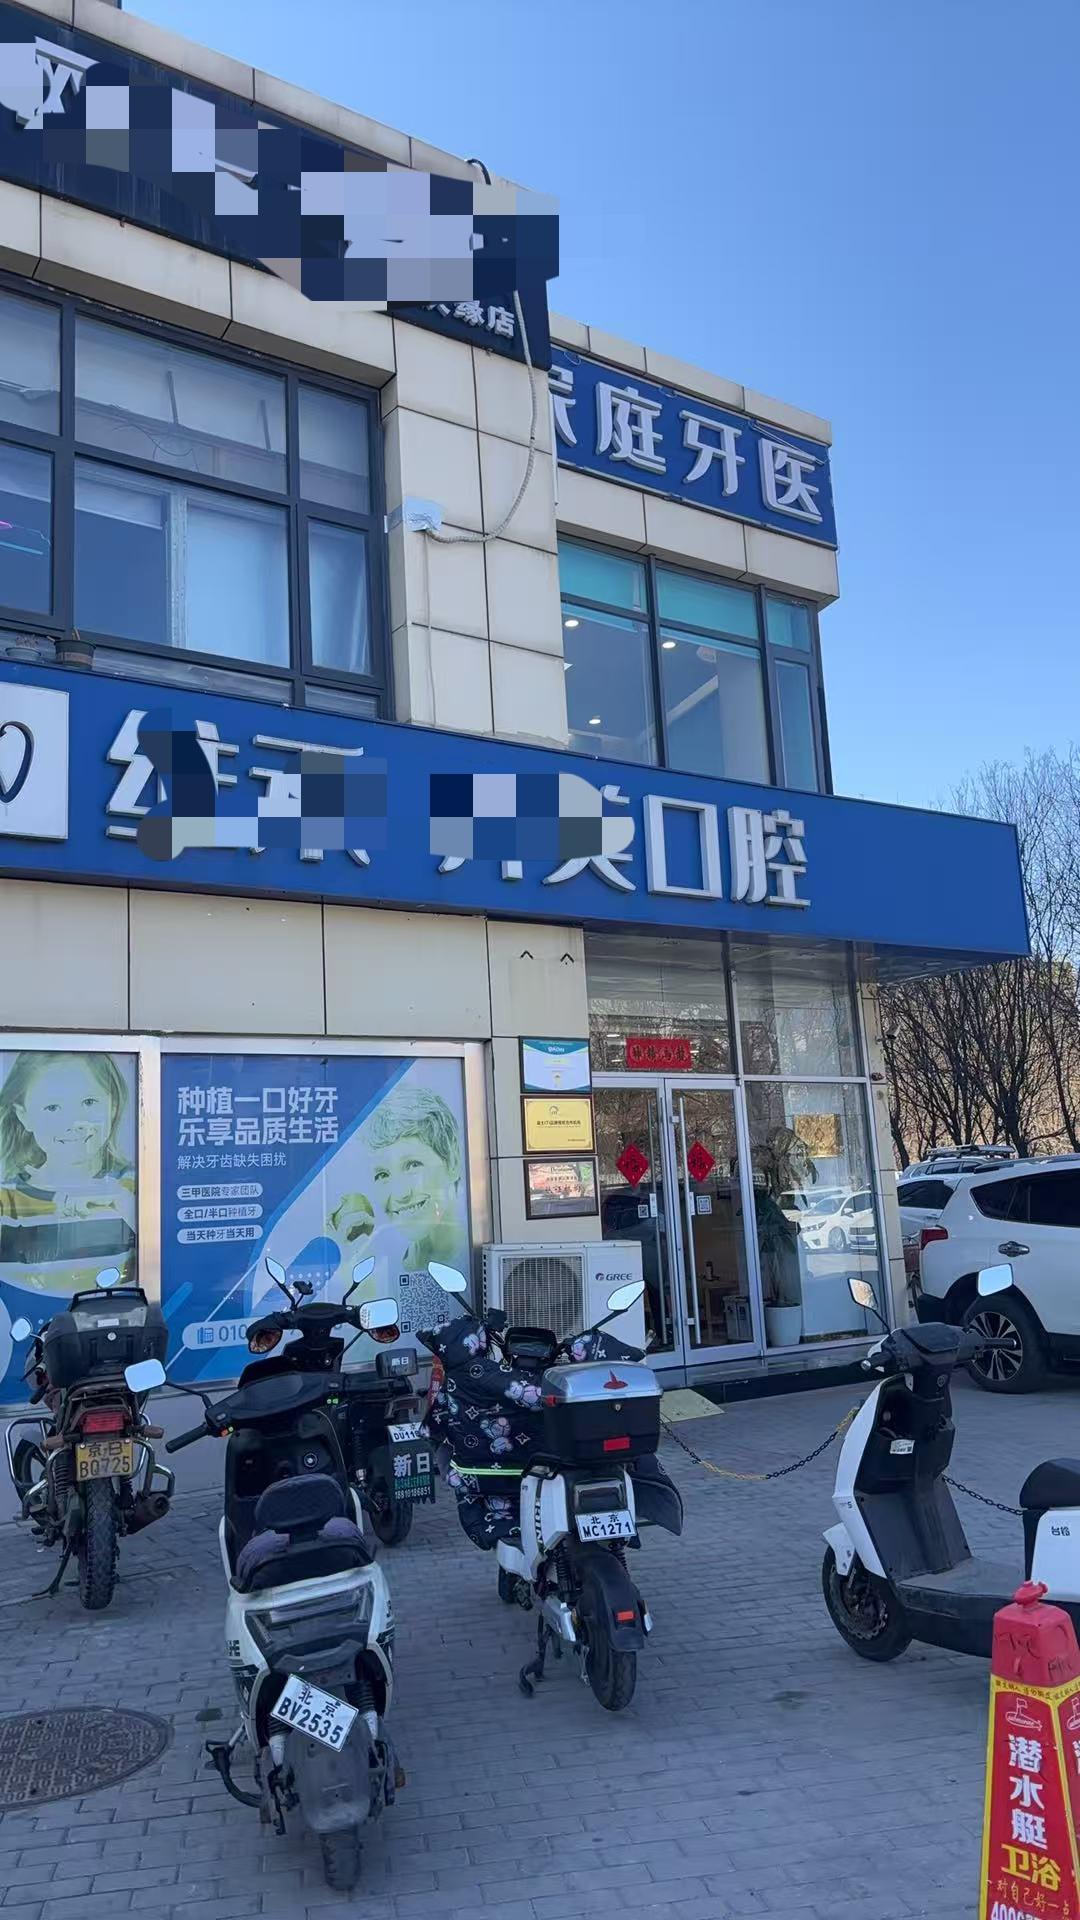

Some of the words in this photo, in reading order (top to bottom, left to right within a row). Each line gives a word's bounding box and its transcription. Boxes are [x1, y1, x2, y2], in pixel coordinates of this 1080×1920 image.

[177, 1086, 339, 1116] 种植一口好牙
[177, 1116, 339, 1147] 乐享品质生活
[177, 1151, 287, 1170] 解决牙齿缺失困扰
[181, 1185, 260, 1199] 三甲医院专家团队
[183, 1206, 257, 1220] 全口/半口种植牙
[186, 1226, 255, 1241] 当天种牙当天用
[605, 1272, 633, 1281] GREE
[394, 1453, 430, 1478] 新日
[582, 1521, 632, 1538] MC1271
[591, 1513, 620, 1525] 北京
[298, 1684, 341, 1718] 北京
[277, 1696, 343, 1744] BV2535
[1008, 1733, 1048, 1850] 潜水艇
[1001, 1843, 1061, 1891] 卫浴
